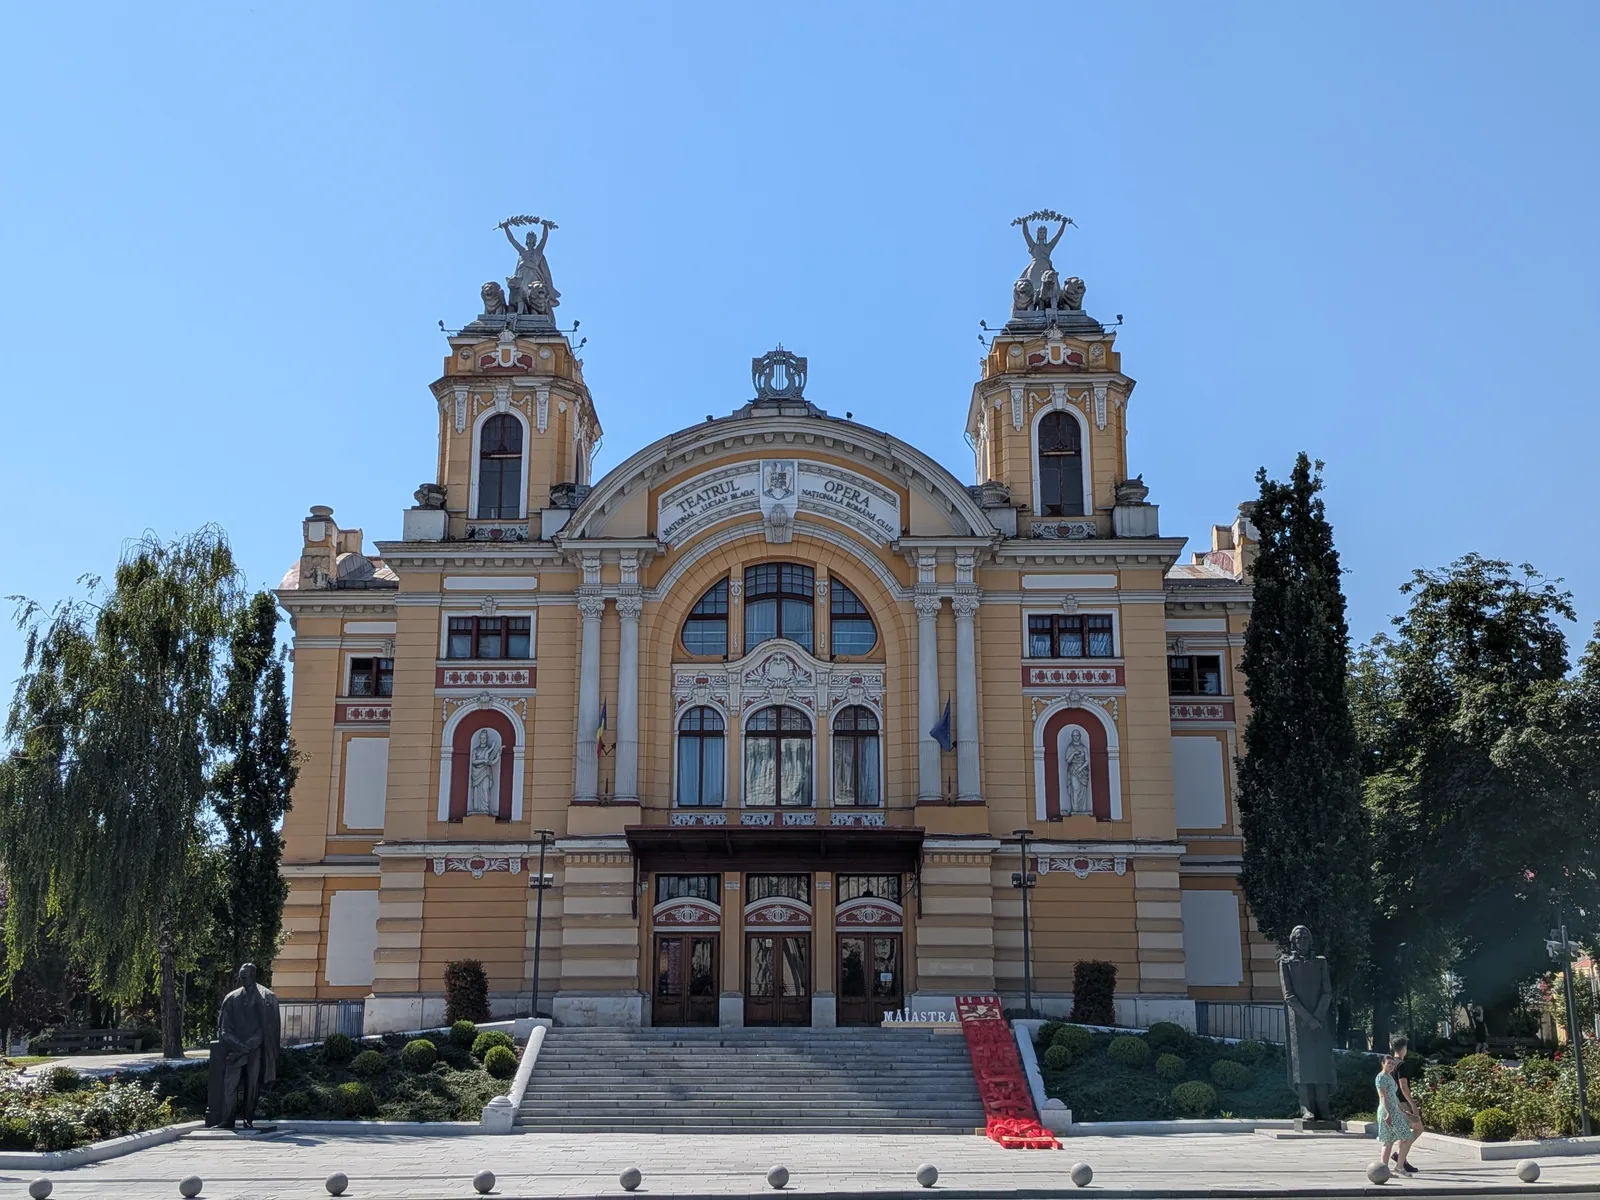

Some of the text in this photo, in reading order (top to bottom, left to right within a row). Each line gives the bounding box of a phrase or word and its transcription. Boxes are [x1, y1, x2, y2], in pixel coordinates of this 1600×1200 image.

[676, 480, 740, 513] TEATRUL
[824, 480, 870, 508] OPERA
[876, 518, 894, 533] CLUJ
